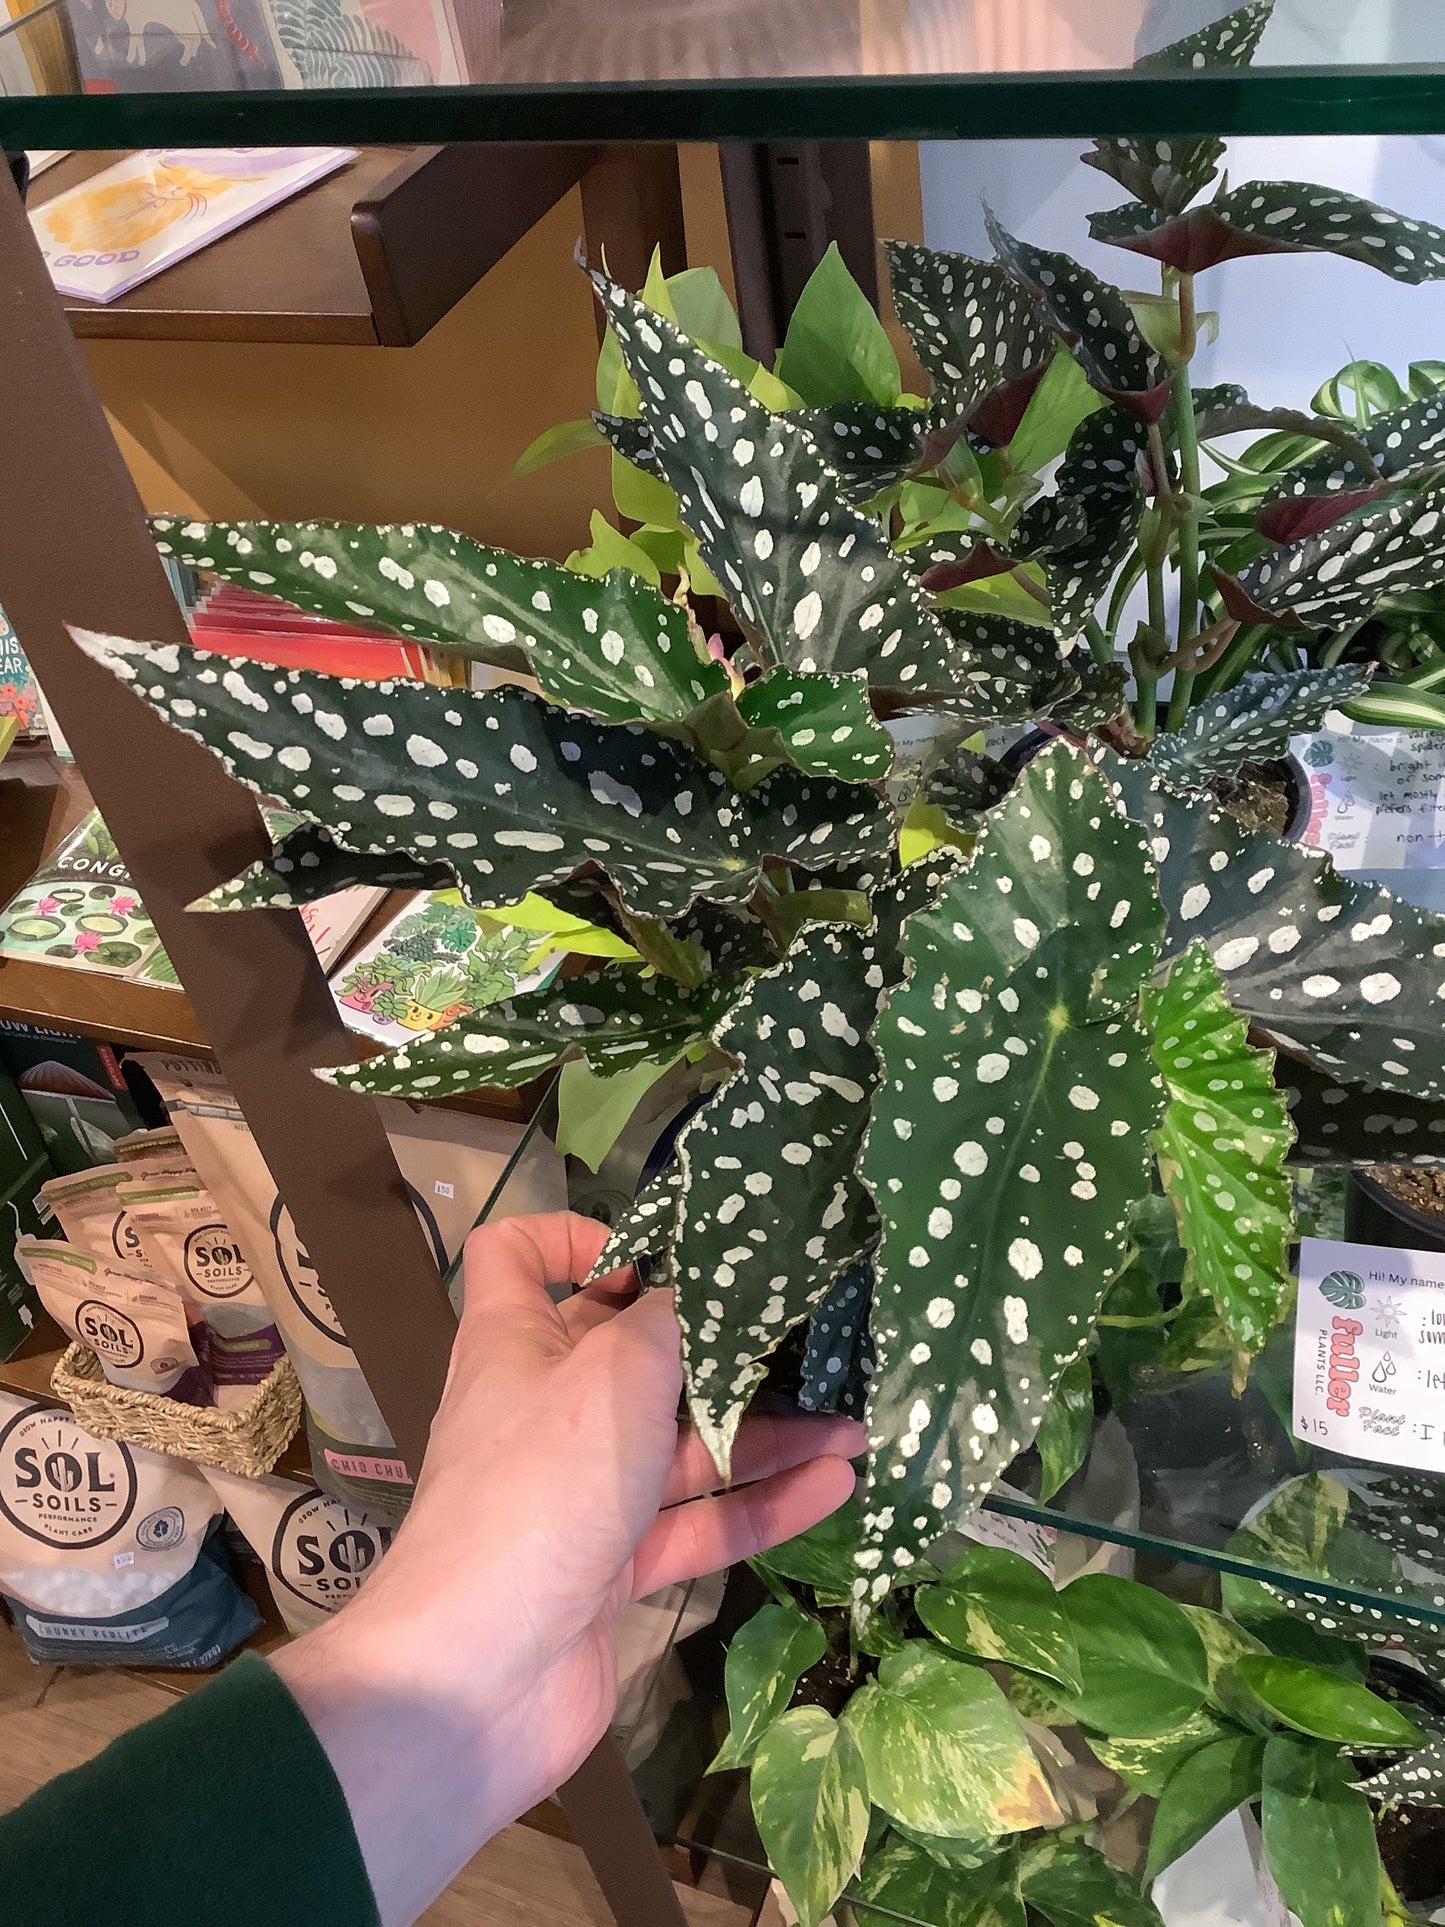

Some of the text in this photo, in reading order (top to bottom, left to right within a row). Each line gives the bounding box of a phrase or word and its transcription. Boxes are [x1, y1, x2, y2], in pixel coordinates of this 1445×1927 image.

[53, 250, 140, 268] GOOD
[1390, 760, 1432, 774] bright
[1397, 775, 1416, 785] or
[195, 1244, 246, 1267] SOL
[204, 1266, 242, 1278] SOILS
[1368, 1271, 1444, 1290] Hi! My name
[84, 1317, 134, 1349] SOL
[1375, 1328, 1398, 1340] Light
[94, 1338, 129, 1355] SOILS
[1314, 1328, 1328, 1396] PLANTS LLC.
[1326, 1315, 1364, 1417] fuller
[1368, 1383, 1397, 1395] Water
[1359, 1405, 1407, 1425] Plant
[19, 1421, 36, 1437] GROW
[1300, 1416, 1329, 1436] $15
[1363, 1419, 1401, 1437] Fact
[14, 1447, 115, 1493] SOL
[374, 1463, 410, 1479] CHU
[32, 1493, 101, 1513] SOILS
[38, 1513, 97, 1523] PERFORMANCE
[44, 1523, 94, 1537] PLANT CARE
[38, 1623, 86, 1638] CHUNKY
